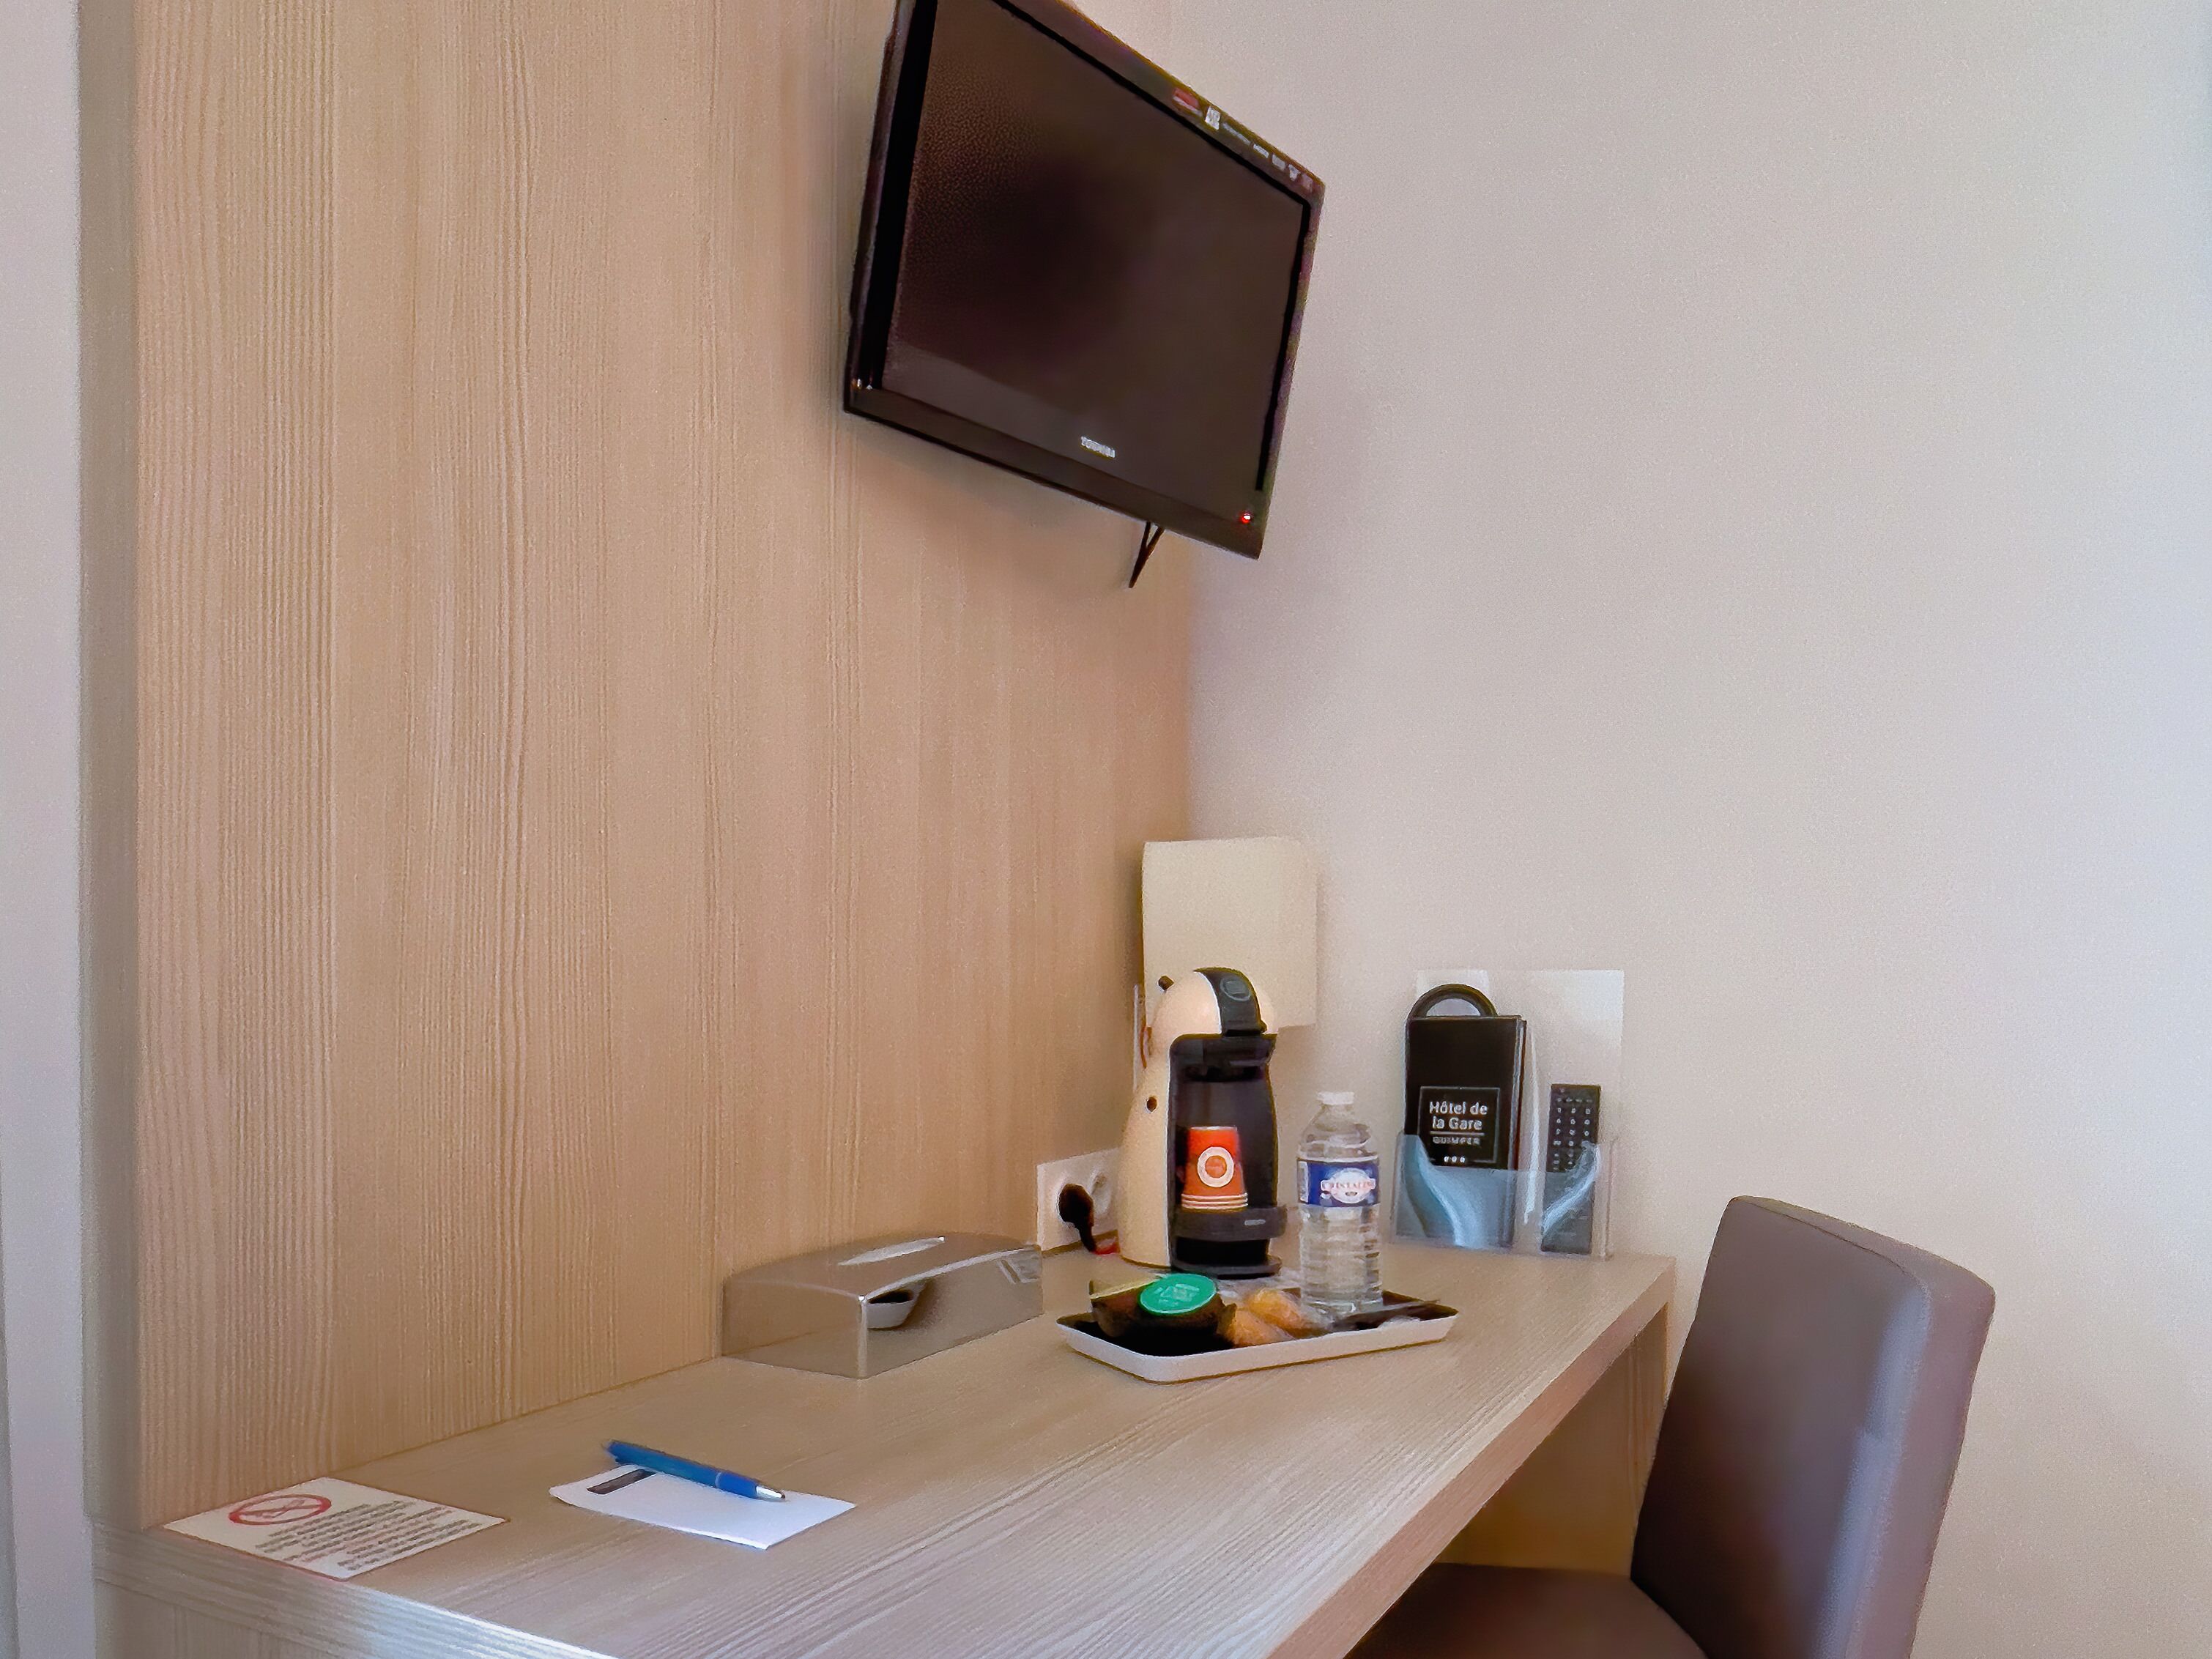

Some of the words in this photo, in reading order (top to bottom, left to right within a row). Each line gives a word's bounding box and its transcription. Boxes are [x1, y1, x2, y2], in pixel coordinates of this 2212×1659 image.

[1429, 1101, 1466, 1114] Hôtel
[1469, 1102, 1488, 1115] de
[1432, 1116, 1445, 1129] la
[1448, 1117, 1482, 1130] Gare
